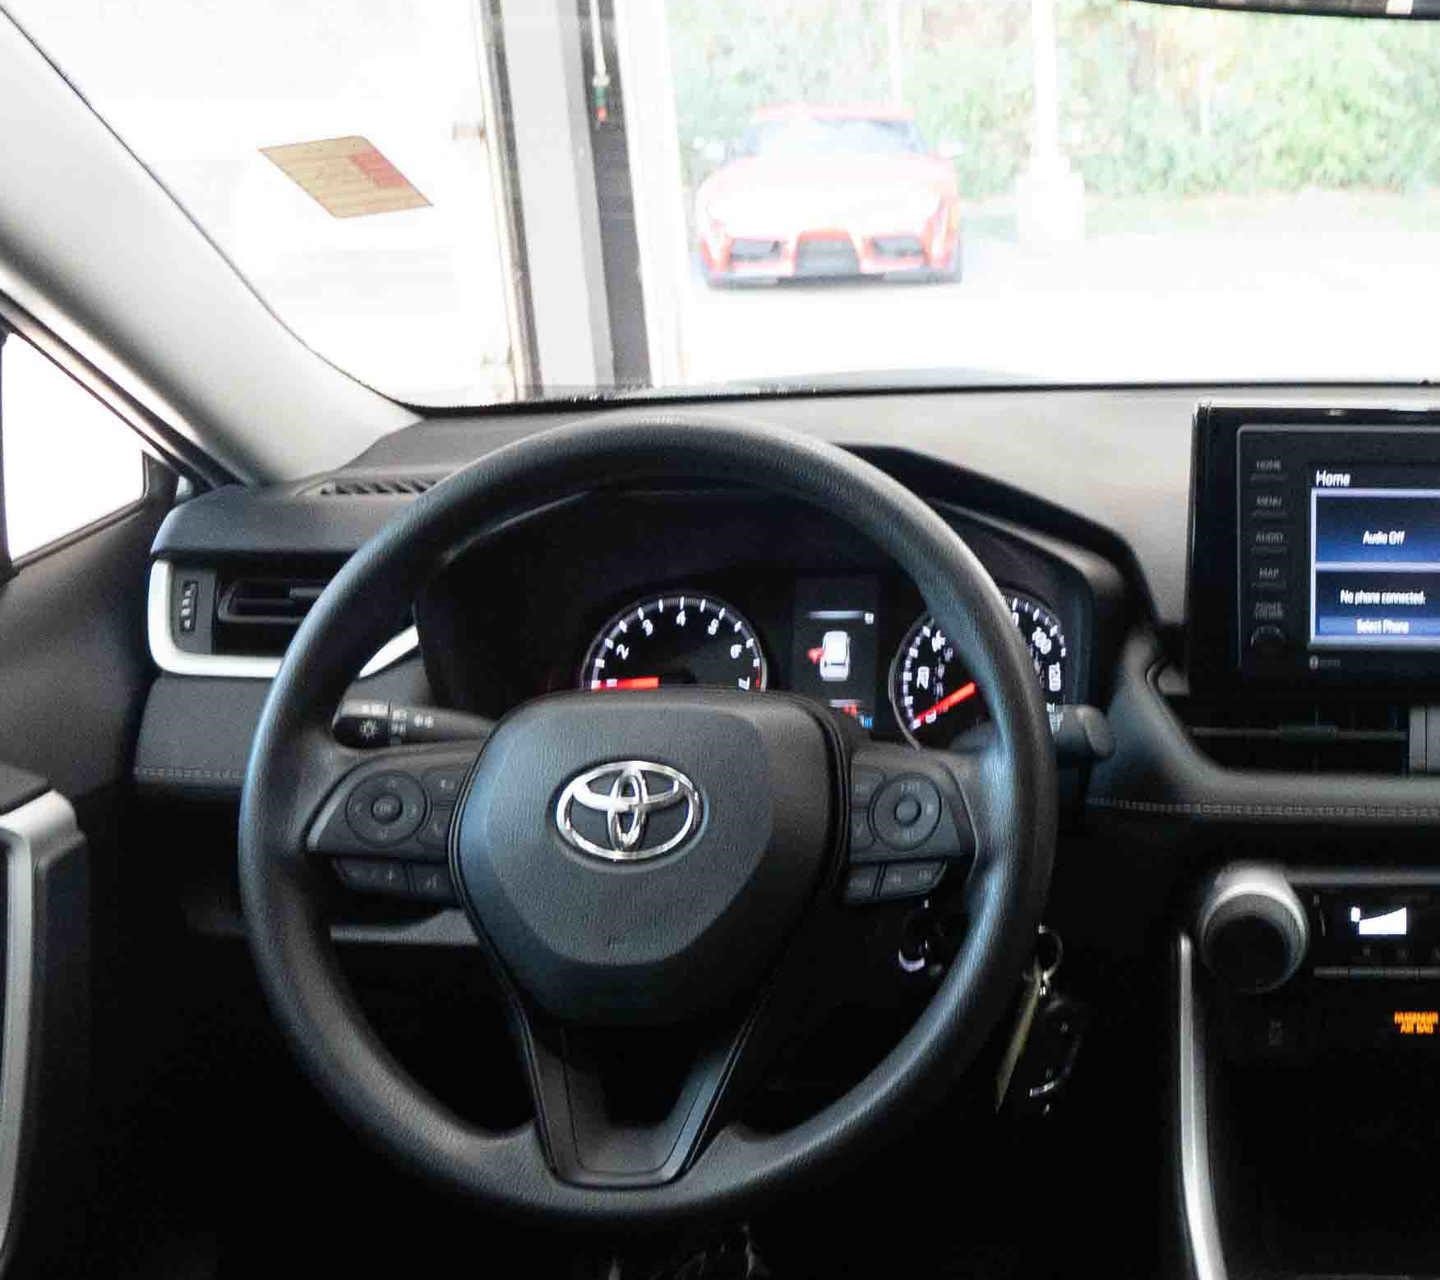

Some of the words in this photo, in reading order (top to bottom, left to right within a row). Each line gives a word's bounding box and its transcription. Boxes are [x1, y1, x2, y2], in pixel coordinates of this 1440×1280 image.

[1316, 470, 1351, 487] Home
[1363, 531, 1389, 545] Audio
[1389, 531, 1405, 545] Off
[1340, 590, 1354, 605] No
[1355, 591, 1381, 606] phone
[676, 610, 687, 627] 4
[616, 643, 630, 660] 2
